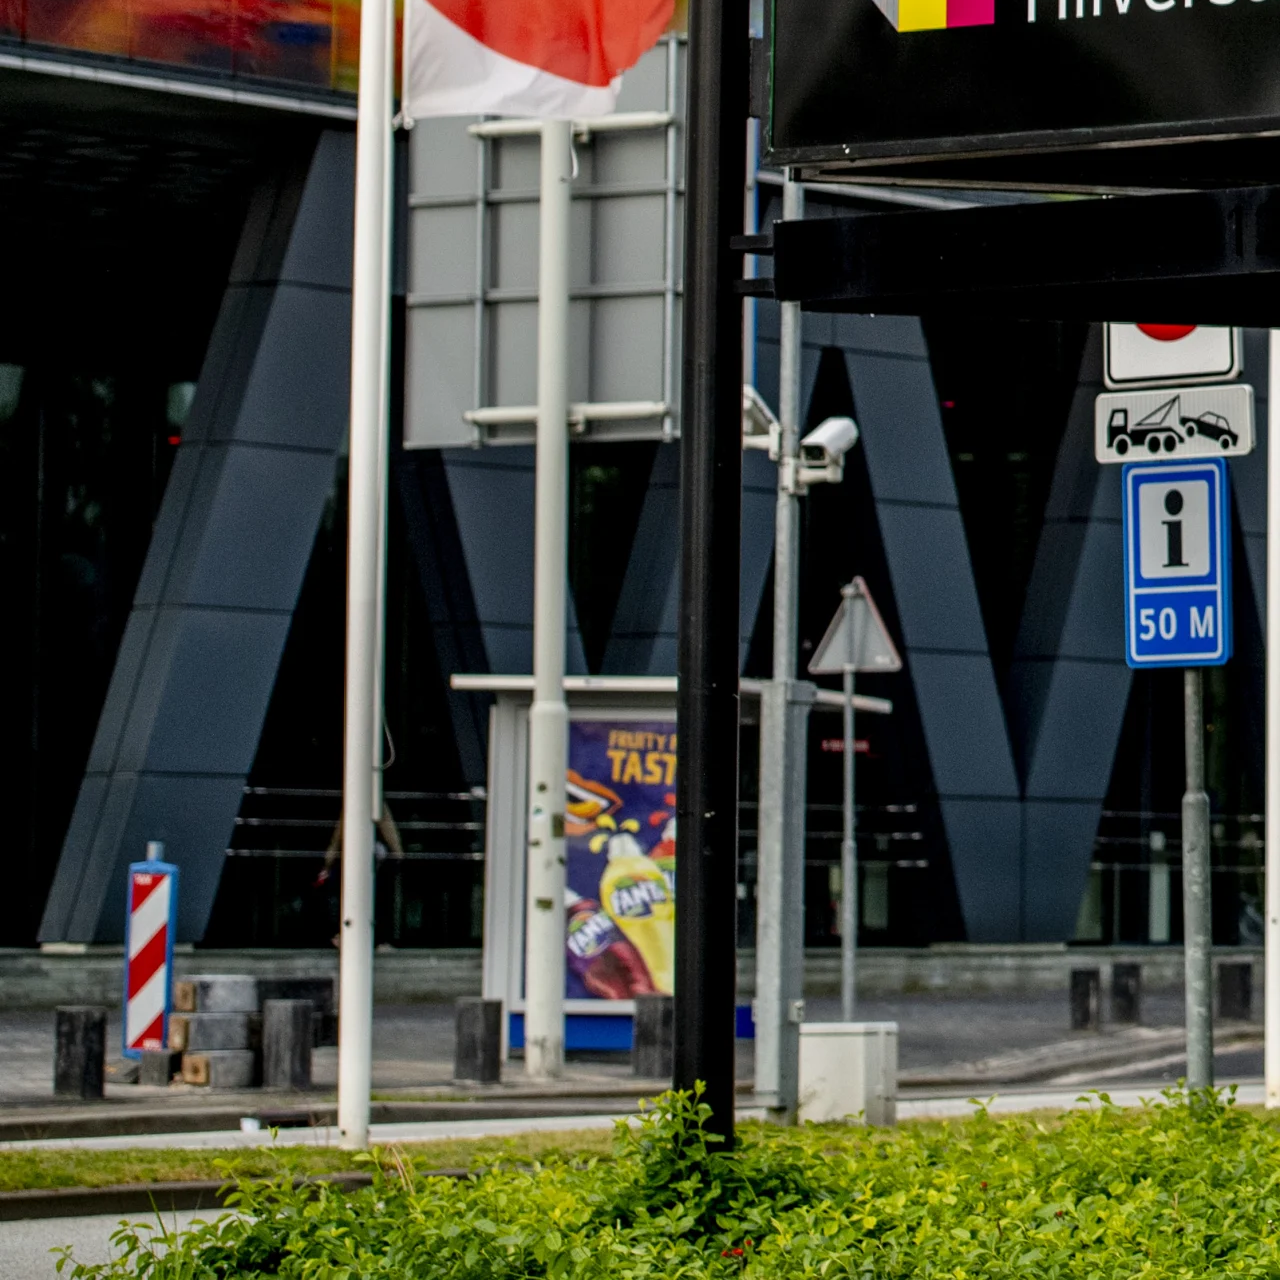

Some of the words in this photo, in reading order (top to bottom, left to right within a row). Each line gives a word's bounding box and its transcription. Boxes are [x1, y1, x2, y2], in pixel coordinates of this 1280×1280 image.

[1139, 607, 1177, 641] 50
[1189, 605, 1215, 639] M
[607, 750, 677, 786] TAST
